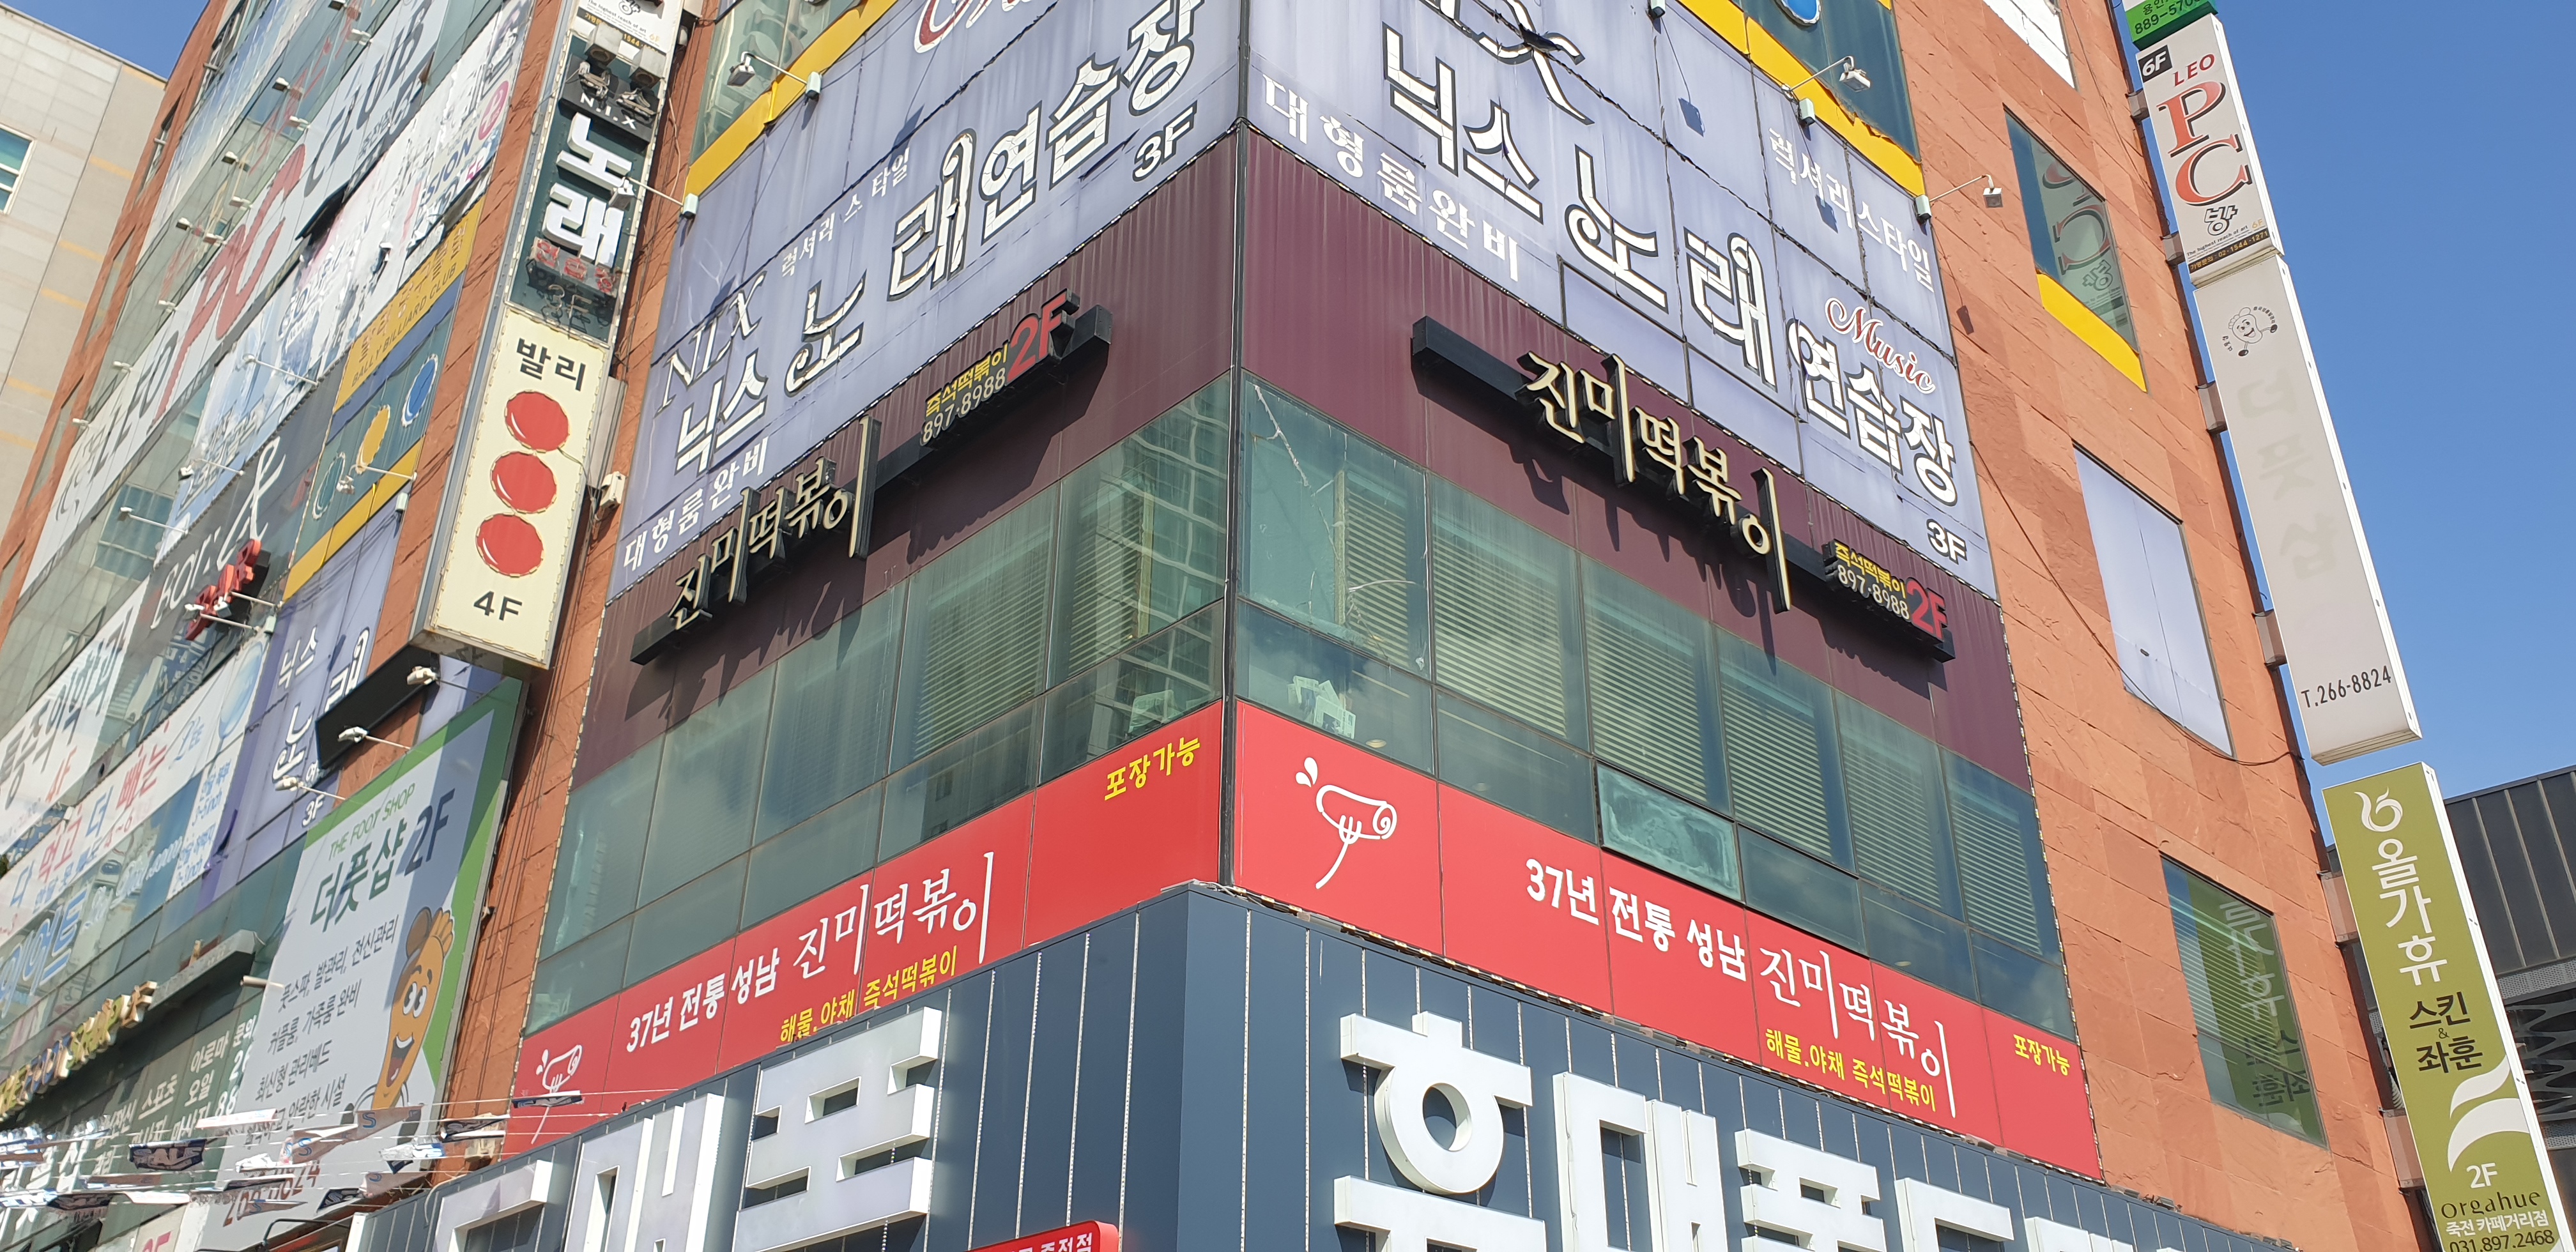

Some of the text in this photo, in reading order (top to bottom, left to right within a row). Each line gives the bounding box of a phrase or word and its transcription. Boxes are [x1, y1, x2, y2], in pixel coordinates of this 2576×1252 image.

[2135, 0, 2200, 34] 889-570
[2142, 50, 2167, 77] 6F
[2173, 53, 2215, 87] LEO
[426, 132, 473, 193] SION
[2156, 80, 2253, 207] PC
[152, 144, 305, 423] PC
[305, 1, 441, 197] CLUB
[556, 112, 632, 269] 노래
[2197, 240, 2216, 252] highest
[2218, 233, 2232, 242] reach
[2204, 205, 2238, 236] 방
[2252, 218, 2264, 230] 6F
[675, 349, 768, 475] 닉스
[1133, 100, 1197, 182] 3F
[1383, 22, 1543, 224] 닉스
[1927, 519, 1966, 564] 3F
[351, 264, 456, 388] BALLY BILLIARD CLUB
[654, 270, 767, 418] NIX
[1825, 298, 1936, 394] Music
[517, 338, 586, 391] 발리
[926, 295, 1068, 418] 즉석떡볶이 2F
[1528, 351, 1790, 613] 진미떡볶이
[668, 415, 874, 630] 진미떡볶이
[473, 591, 523, 621] 4F
[1835, 541, 1948, 641] 즉석떡볶이 2F
[278, 625, 318, 689] 닉스
[2301, 664, 2392, 709] T.266-8824
[1104, 737, 1201, 800] 포장가능
[86, 786, 114, 837] 더
[302, 794, 324, 827] 3F
[328, 783, 415, 860] THE FOOT SHOP
[310, 816, 408, 932] 더풋샵
[404, 788, 455, 876] 2F
[2372, 838, 2448, 986] 올가휴
[352, 915, 399, 966] 전신관리
[625, 851, 994, 1053] 37년 전통 성남 진미떡볶이
[864, 945, 958, 1010] 즉석떡볶이
[1526, 859, 1956, 1120] 37년 전통 성남 진미떡볶이
[302, 995, 336, 1034] 가족룸
[337, 979, 362, 1016] 완비
[2408, 991, 2471, 1030] 스킨
[2438, 1027, 2450, 1040] &
[191, 1030, 230, 1071] 아로마
[256, 1040, 332, 1102] 최신형 관리베드
[2014, 1034, 2070, 1076] 포장가능
[2417, 1035, 2483, 1073] 좌훈
[139, 1074, 178, 1119] 스포츠
[185, 1070, 214, 1106] 오일
[289, 1073, 347, 1123] 안락한 시설
[1852, 1059, 1935, 1113] 즉석떡볶이
[2466, 1163, 2497, 1189] 2F
[2441, 1192, 2541, 1219] Orgahue
[2446, 1210, 2549, 1237] 죽전 카페거리점
